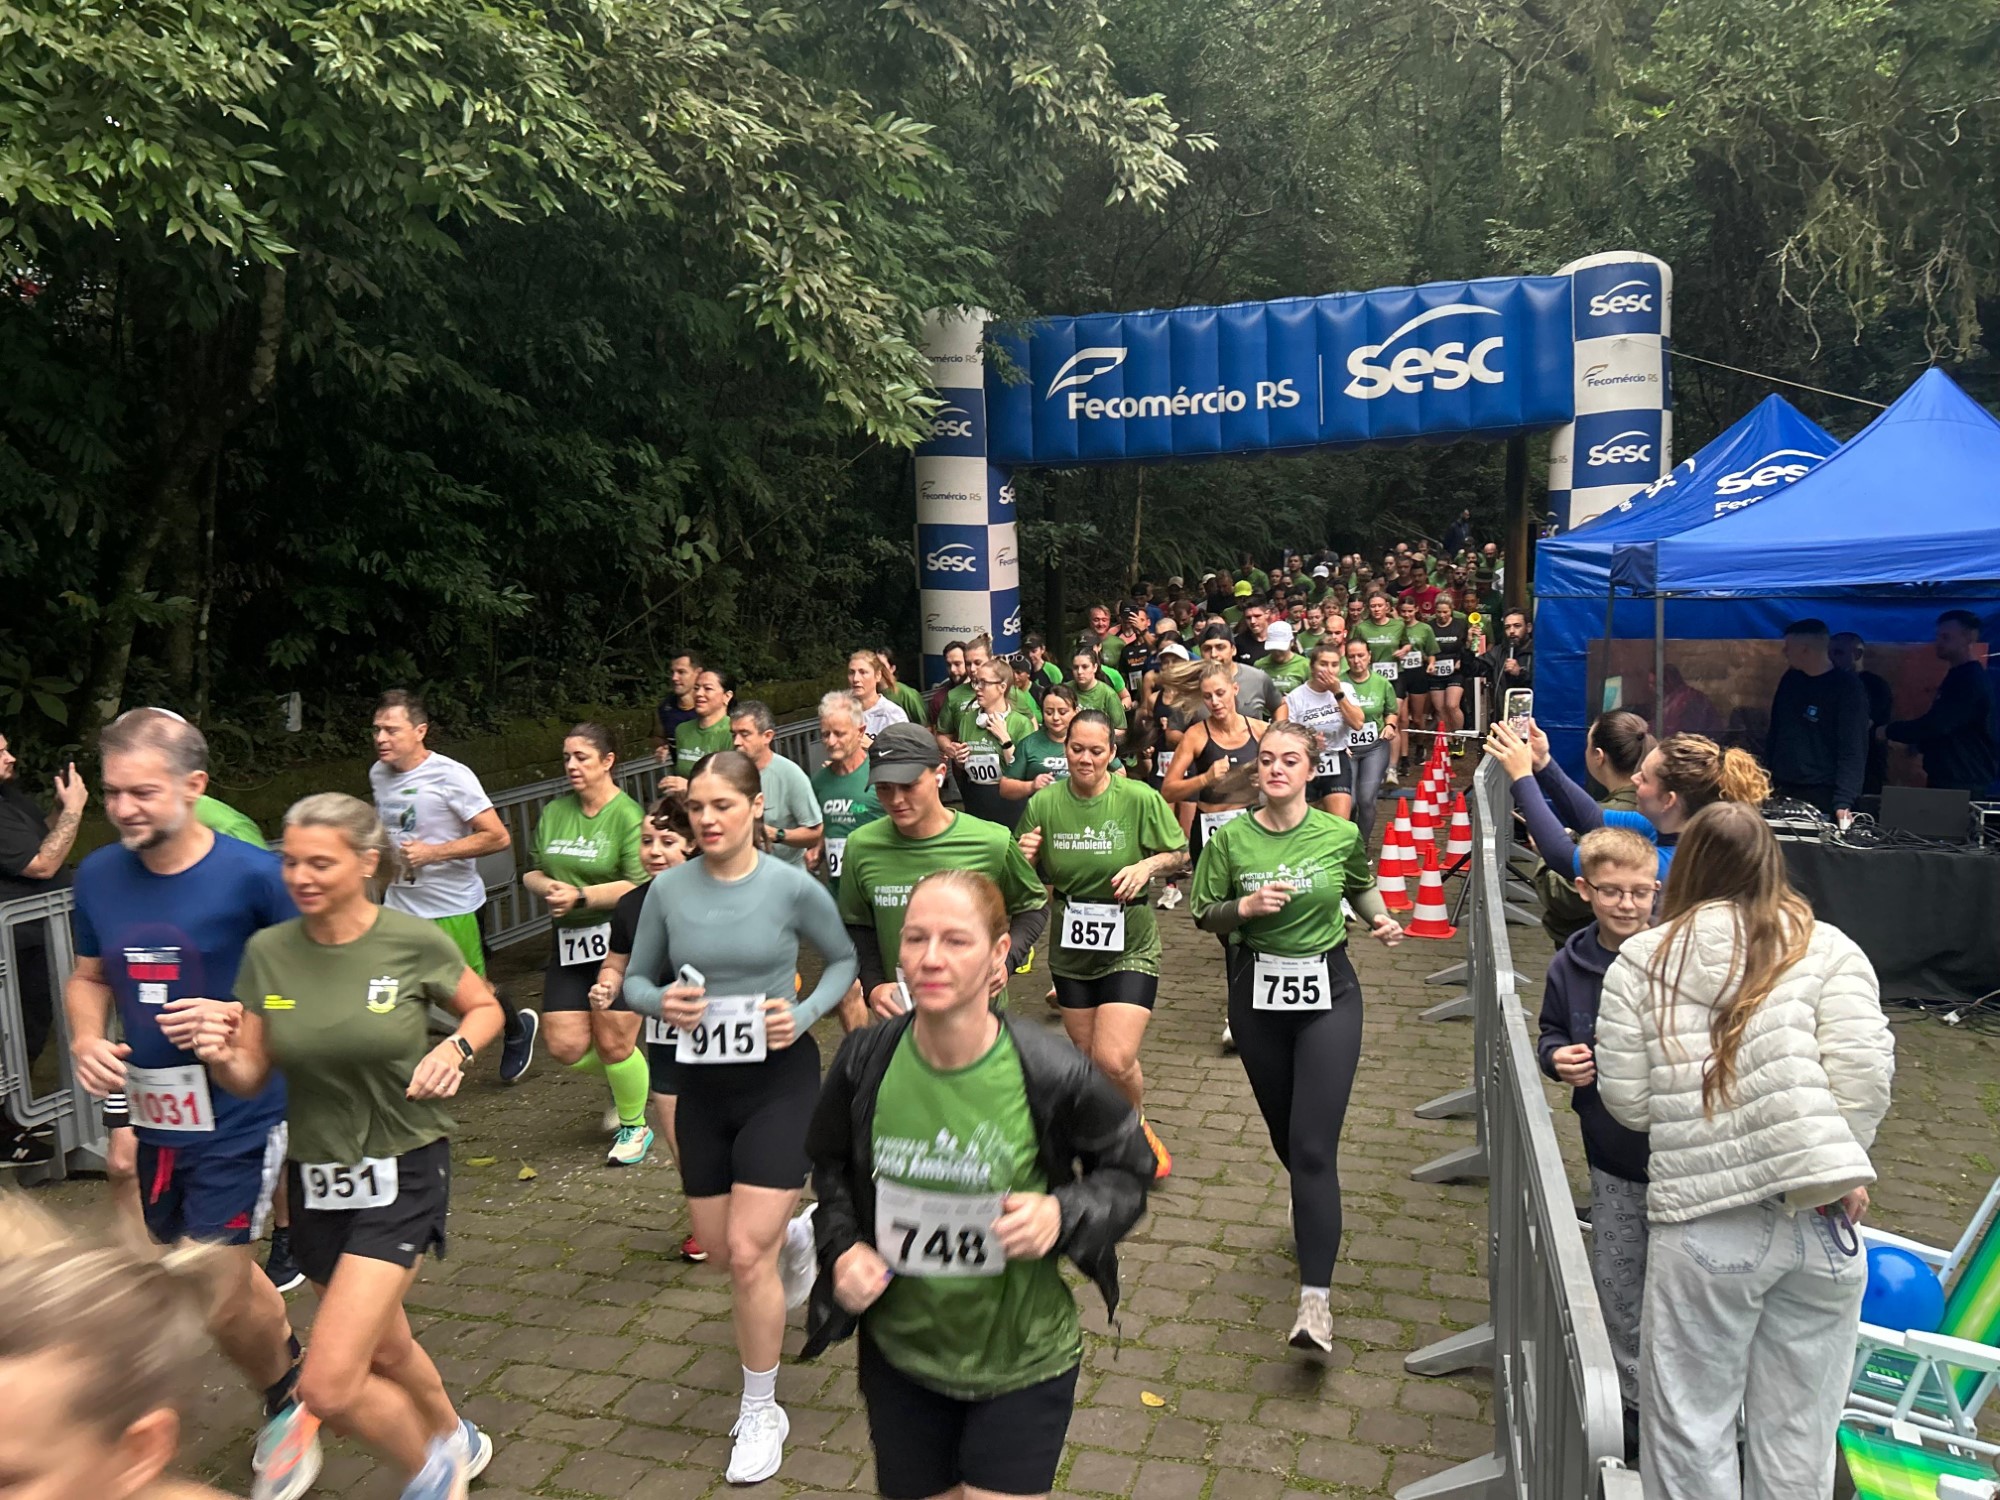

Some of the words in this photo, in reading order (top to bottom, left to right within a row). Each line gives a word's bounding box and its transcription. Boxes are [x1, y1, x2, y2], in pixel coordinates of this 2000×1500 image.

[1589, 293, 1652, 316] Sesc
[965, 354, 978, 363] RS
[1344, 336, 1504, 400] Sesc
[1588, 374, 1646, 387] Fecomércio
[1647, 373, 1658, 382] RS
[1068, 385, 1247, 420] Fecomércio
[1257, 378, 1300, 410] RS
[1587, 444, 1651, 466] Sesc
[922, 488, 967, 501] Fecomércio
[969, 493, 982, 501] RS
[927, 552, 976, 572] Sesc
[928, 624, 971, 633] Fecomércio
[1401, 657, 1420, 666] 785
[1435, 665, 1451, 674] 769
[1320, 706, 1340, 717] VALE
[1350, 731, 1374, 745] 843
[970, 765, 997, 780] 900
[823, 798, 853, 814] CDV
[1053, 839, 1070, 850] Meio
[1072, 839, 1112, 850] Ambiente
[830, 854, 843, 872] 9
[875, 894, 898, 906] Meio
[1070, 919, 1116, 947] 857
[565, 934, 606, 960] 718
[1263, 974, 1320, 1005] 755
[691, 1021, 754, 1055] 915
[132, 1091, 201, 1126] 1031
[307, 1163, 381, 1198] 951
[890, 1217, 988, 1267] 748
